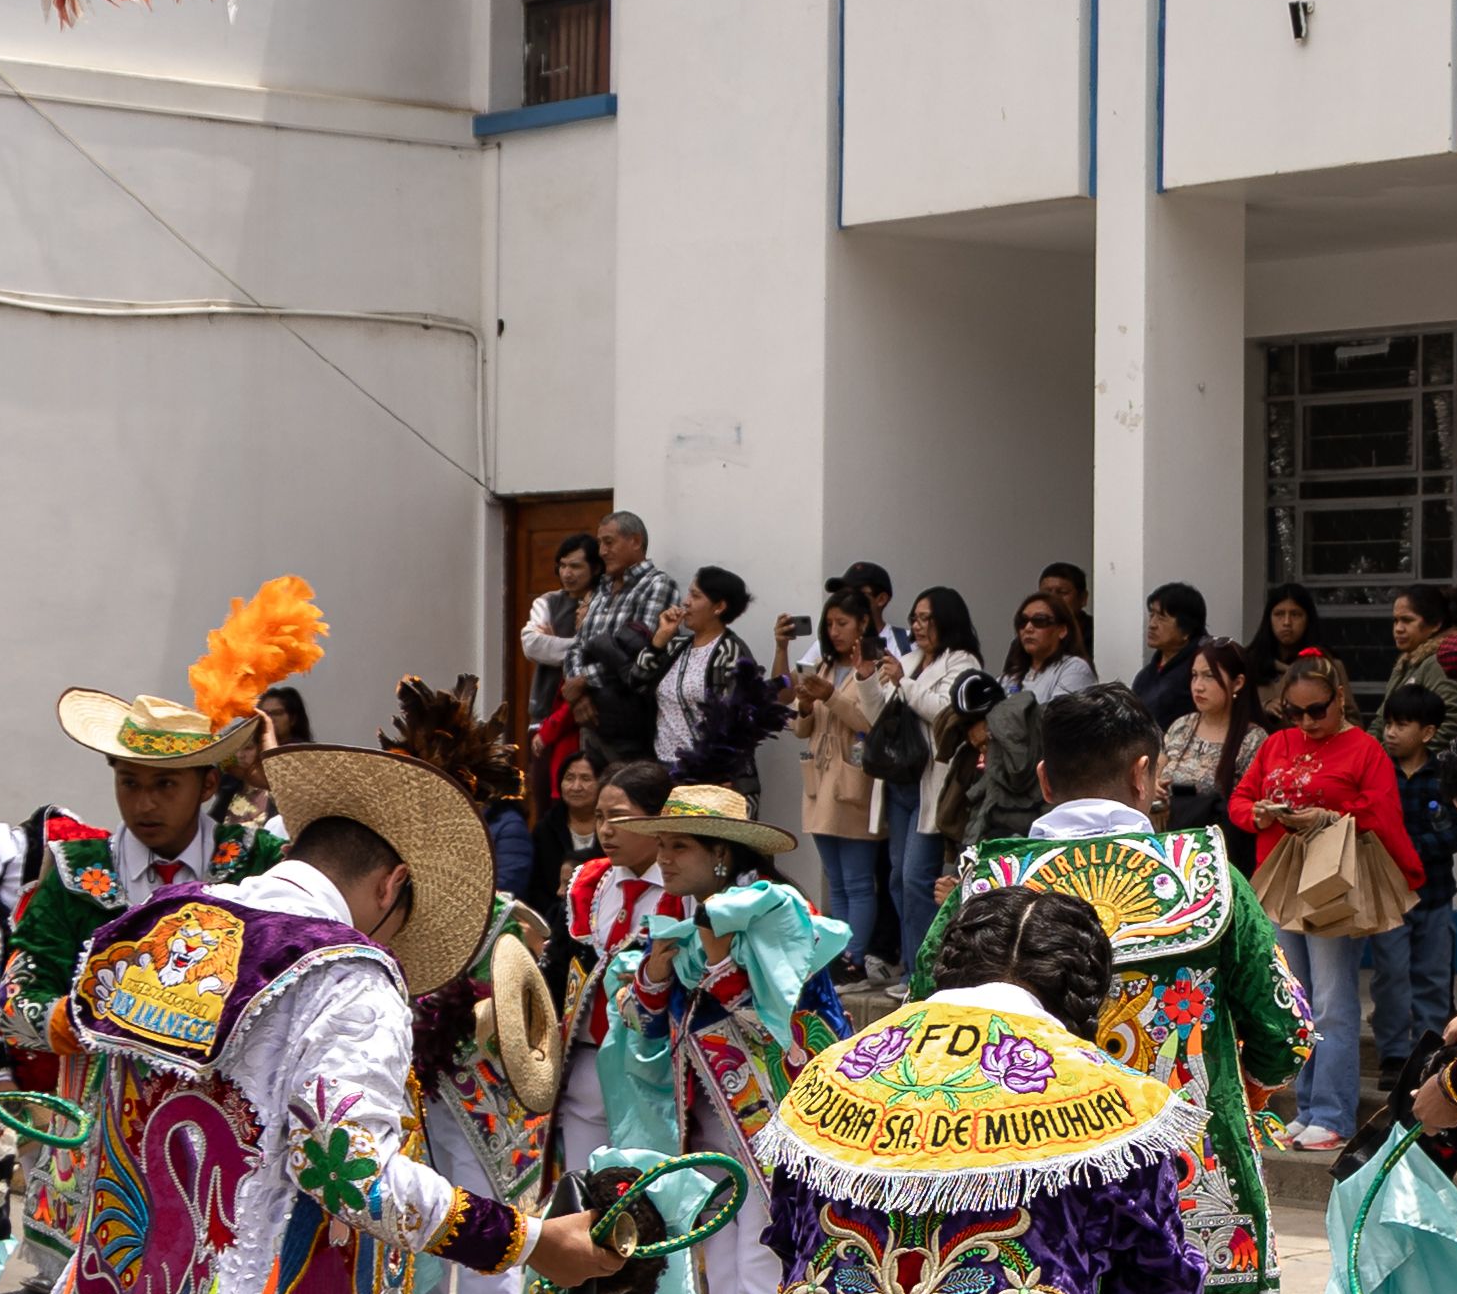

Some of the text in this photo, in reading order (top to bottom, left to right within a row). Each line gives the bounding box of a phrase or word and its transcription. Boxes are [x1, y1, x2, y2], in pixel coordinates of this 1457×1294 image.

[916, 1024, 981, 1056] FD
[930, 1113, 973, 1148] DE
[984, 1089, 1133, 1146] MURUHUAY
